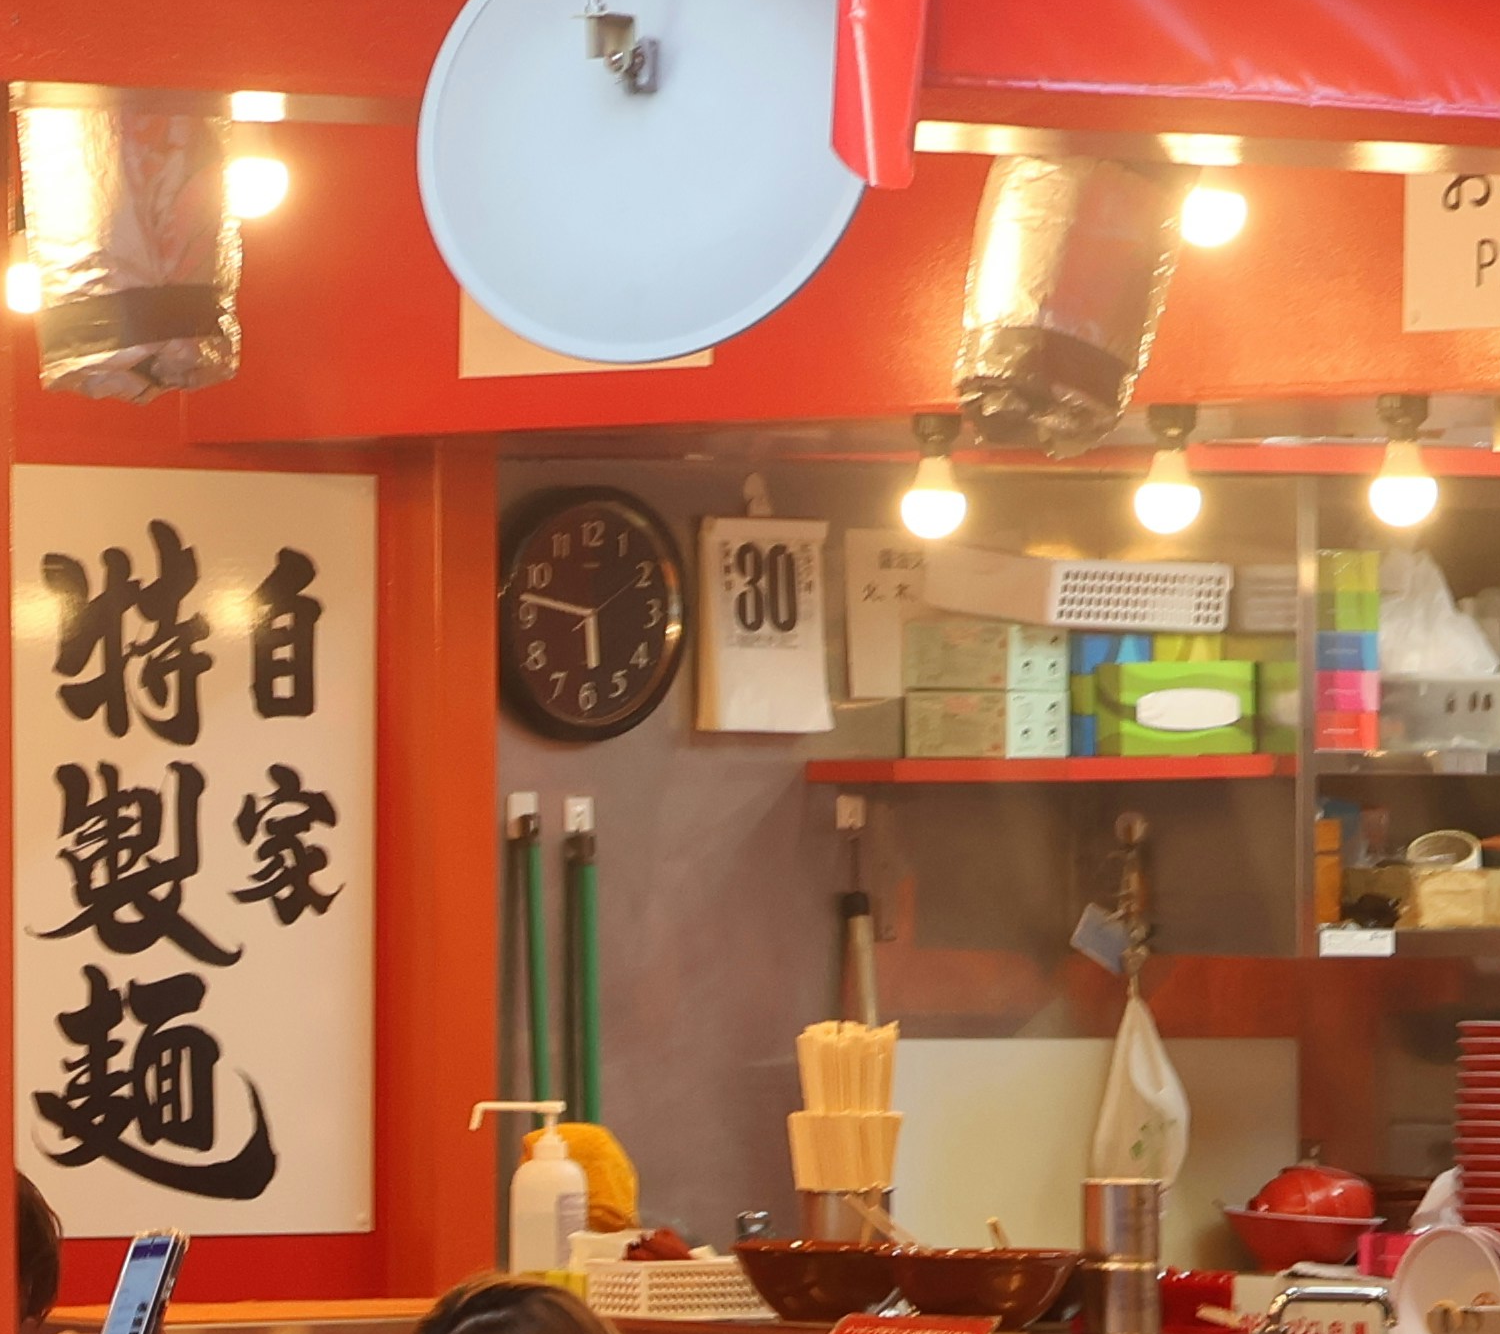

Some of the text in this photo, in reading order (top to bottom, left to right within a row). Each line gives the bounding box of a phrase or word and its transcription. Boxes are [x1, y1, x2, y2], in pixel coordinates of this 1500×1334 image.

[552, 533, 571, 558] 11
[581, 520, 606, 547] 12
[617, 531, 630, 557] 1
[527, 562, 551, 590] 10
[635, 561, 654, 588] 2
[735, 542, 798, 633] 30
[518, 601, 538, 629] 9
[643, 598, 663, 629] 3
[525, 640, 548, 671] 8
[629, 641, 651, 669] 4
[547, 670, 569, 704] 7
[577, 681, 598, 711] 6
[608, 669, 630, 699] 5
[231, 547, 346, 925] 自家
